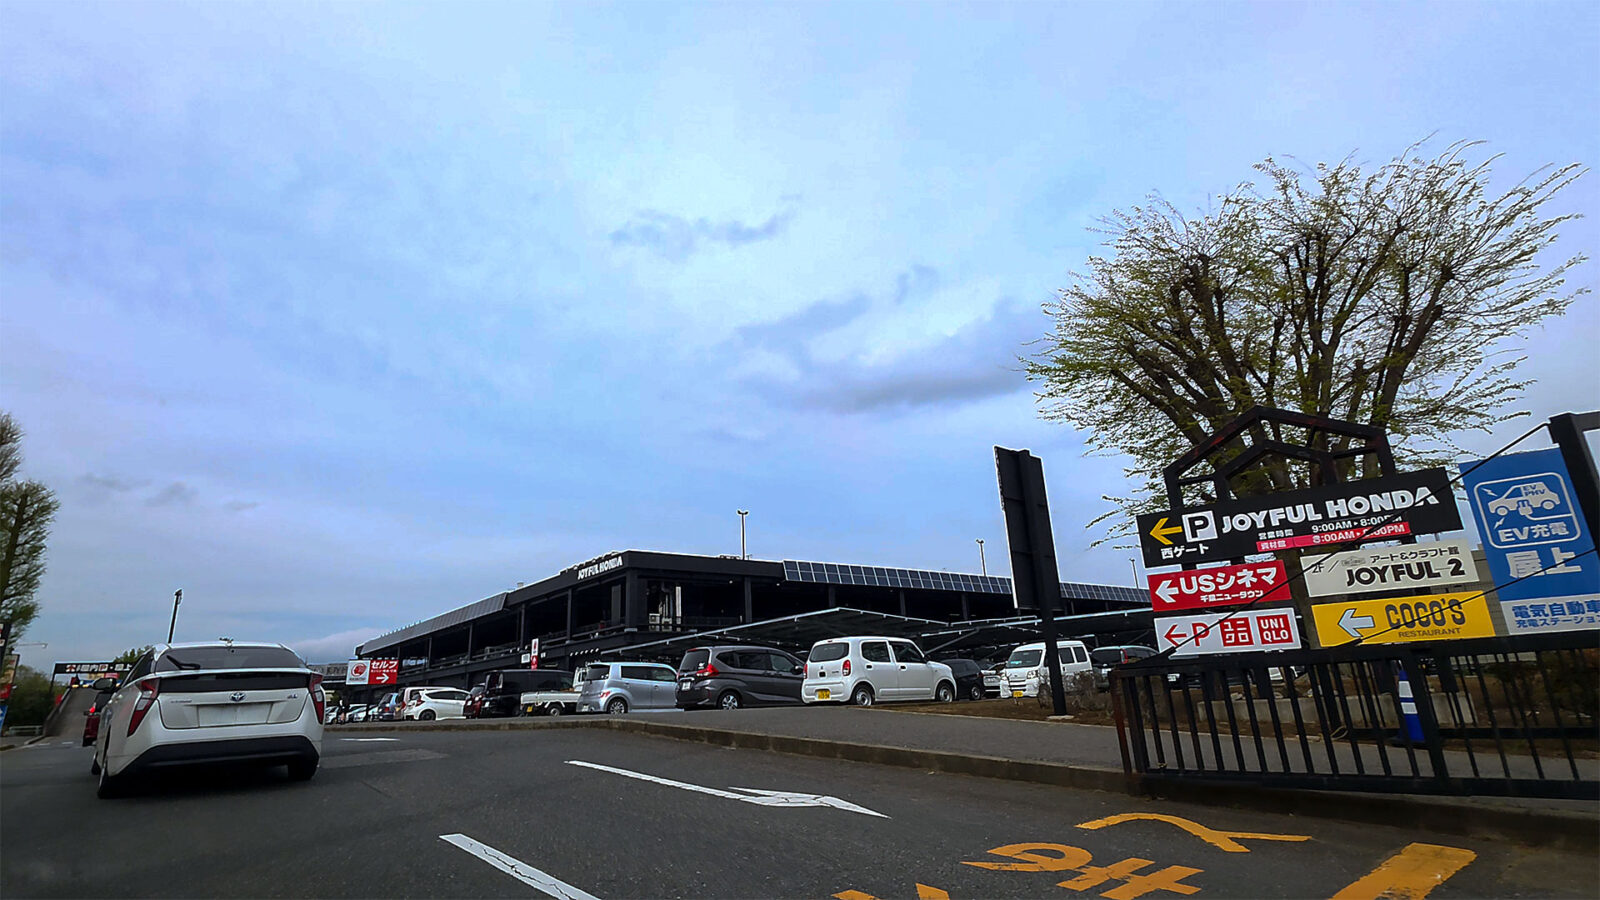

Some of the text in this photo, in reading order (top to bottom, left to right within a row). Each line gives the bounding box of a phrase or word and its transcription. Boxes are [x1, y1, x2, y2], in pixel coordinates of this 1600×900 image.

[1222, 504, 1322, 533] JOYFUL
[1325, 487, 1440, 518] HONDA
[1312, 520, 1352, 533] 9:00AM
[1498, 522, 1570, 542] EV充電
[1161, 543, 1209, 559] 西ゲート
[578, 556, 623, 580] JOYFUL HONDA
[1180, 567, 1277, 594] USシネマ
[1385, 598, 1465, 629] COCO'S
[1512, 600, 1600, 619] 電気自動車
[1224, 620, 1248, 631] ユニ
[1260, 618, 1285, 629] UNI
[1192, 622, 1211, 646] P
[1225, 632, 1250, 643] クロ
[1263, 630, 1289, 642] QLO
[1398, 628, 1462, 638] RESTAURANT
[370, 661, 398, 669] セルフ
